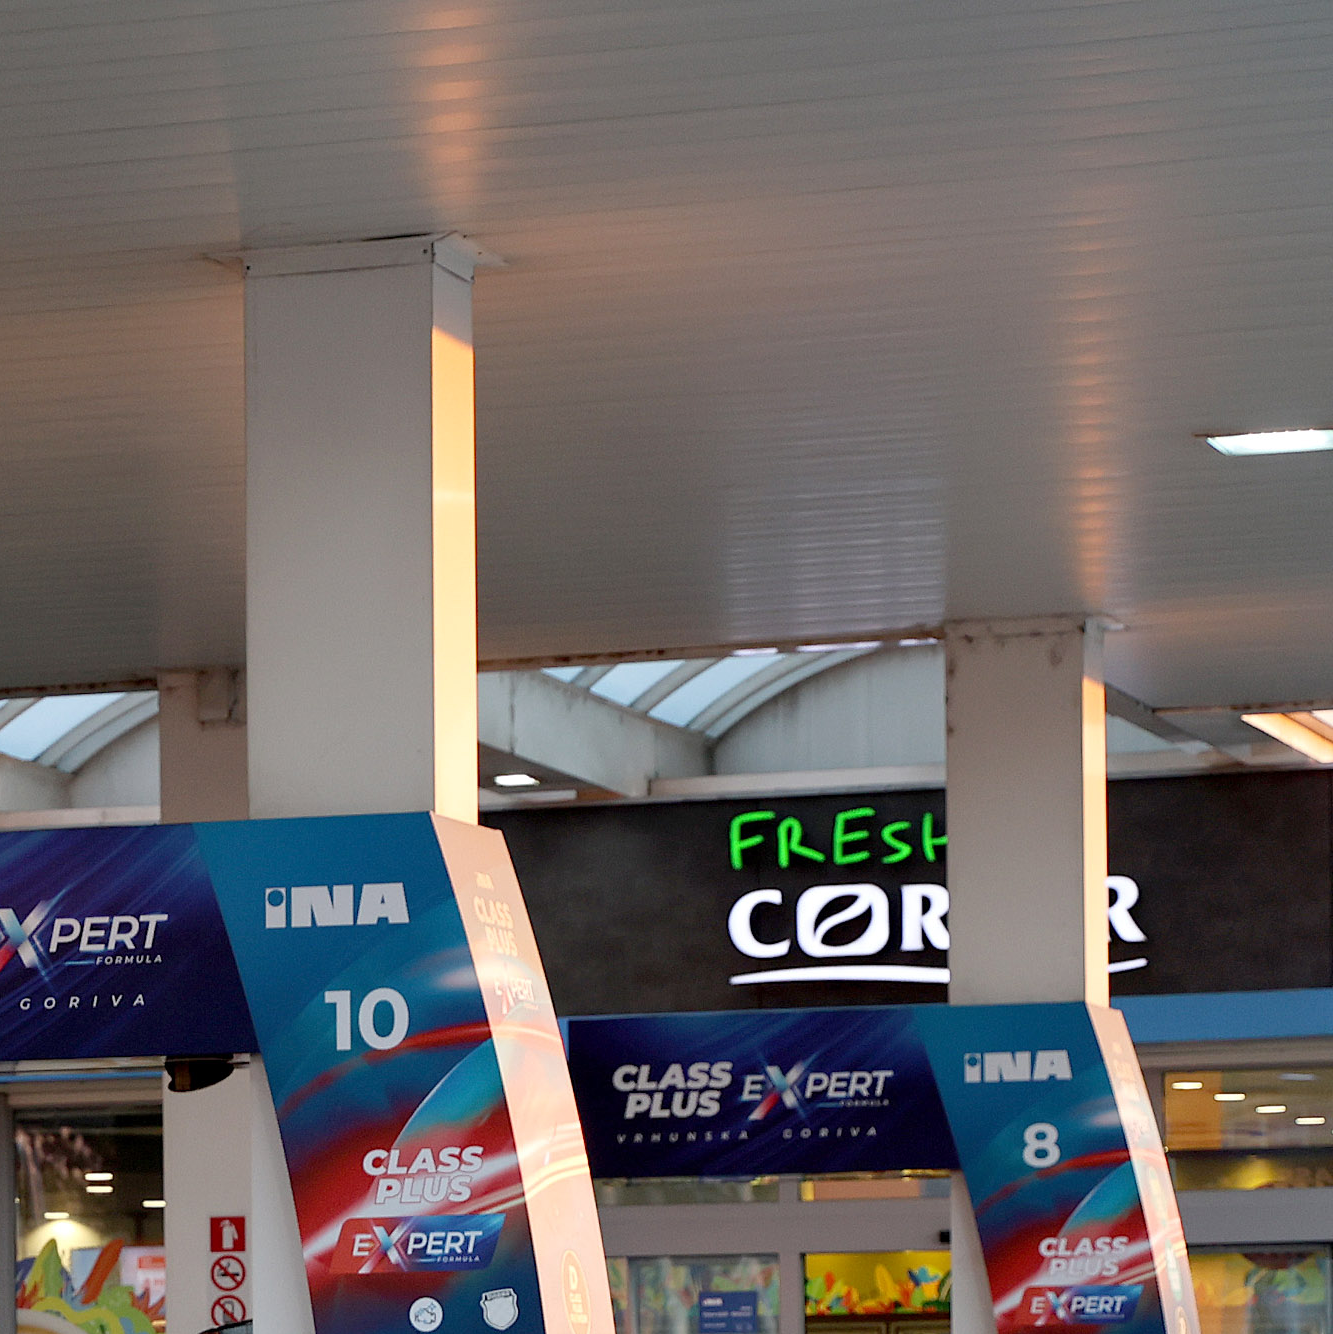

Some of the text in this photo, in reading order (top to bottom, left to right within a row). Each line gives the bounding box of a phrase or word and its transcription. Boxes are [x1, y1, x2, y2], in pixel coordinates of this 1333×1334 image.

[727, 875, 1148, 959] CORR
[95, 954, 163, 966] FORMULA
[20, 993, 146, 1011] GORIVA
[324, 987, 410, 1051] 10
[612, 1061, 733, 1092] CLASS
[742, 1059, 894, 1121] EXPERT
[624, 1090, 721, 1119] PLUS
[362, 1145, 484, 1176] CLASS
[1023, 1122, 1061, 1168] 8
[375, 1174, 472, 1205] PLUS
[1039, 1236, 1130, 1258] CLASS
[1049, 1257, 1120, 1278] PLUS
